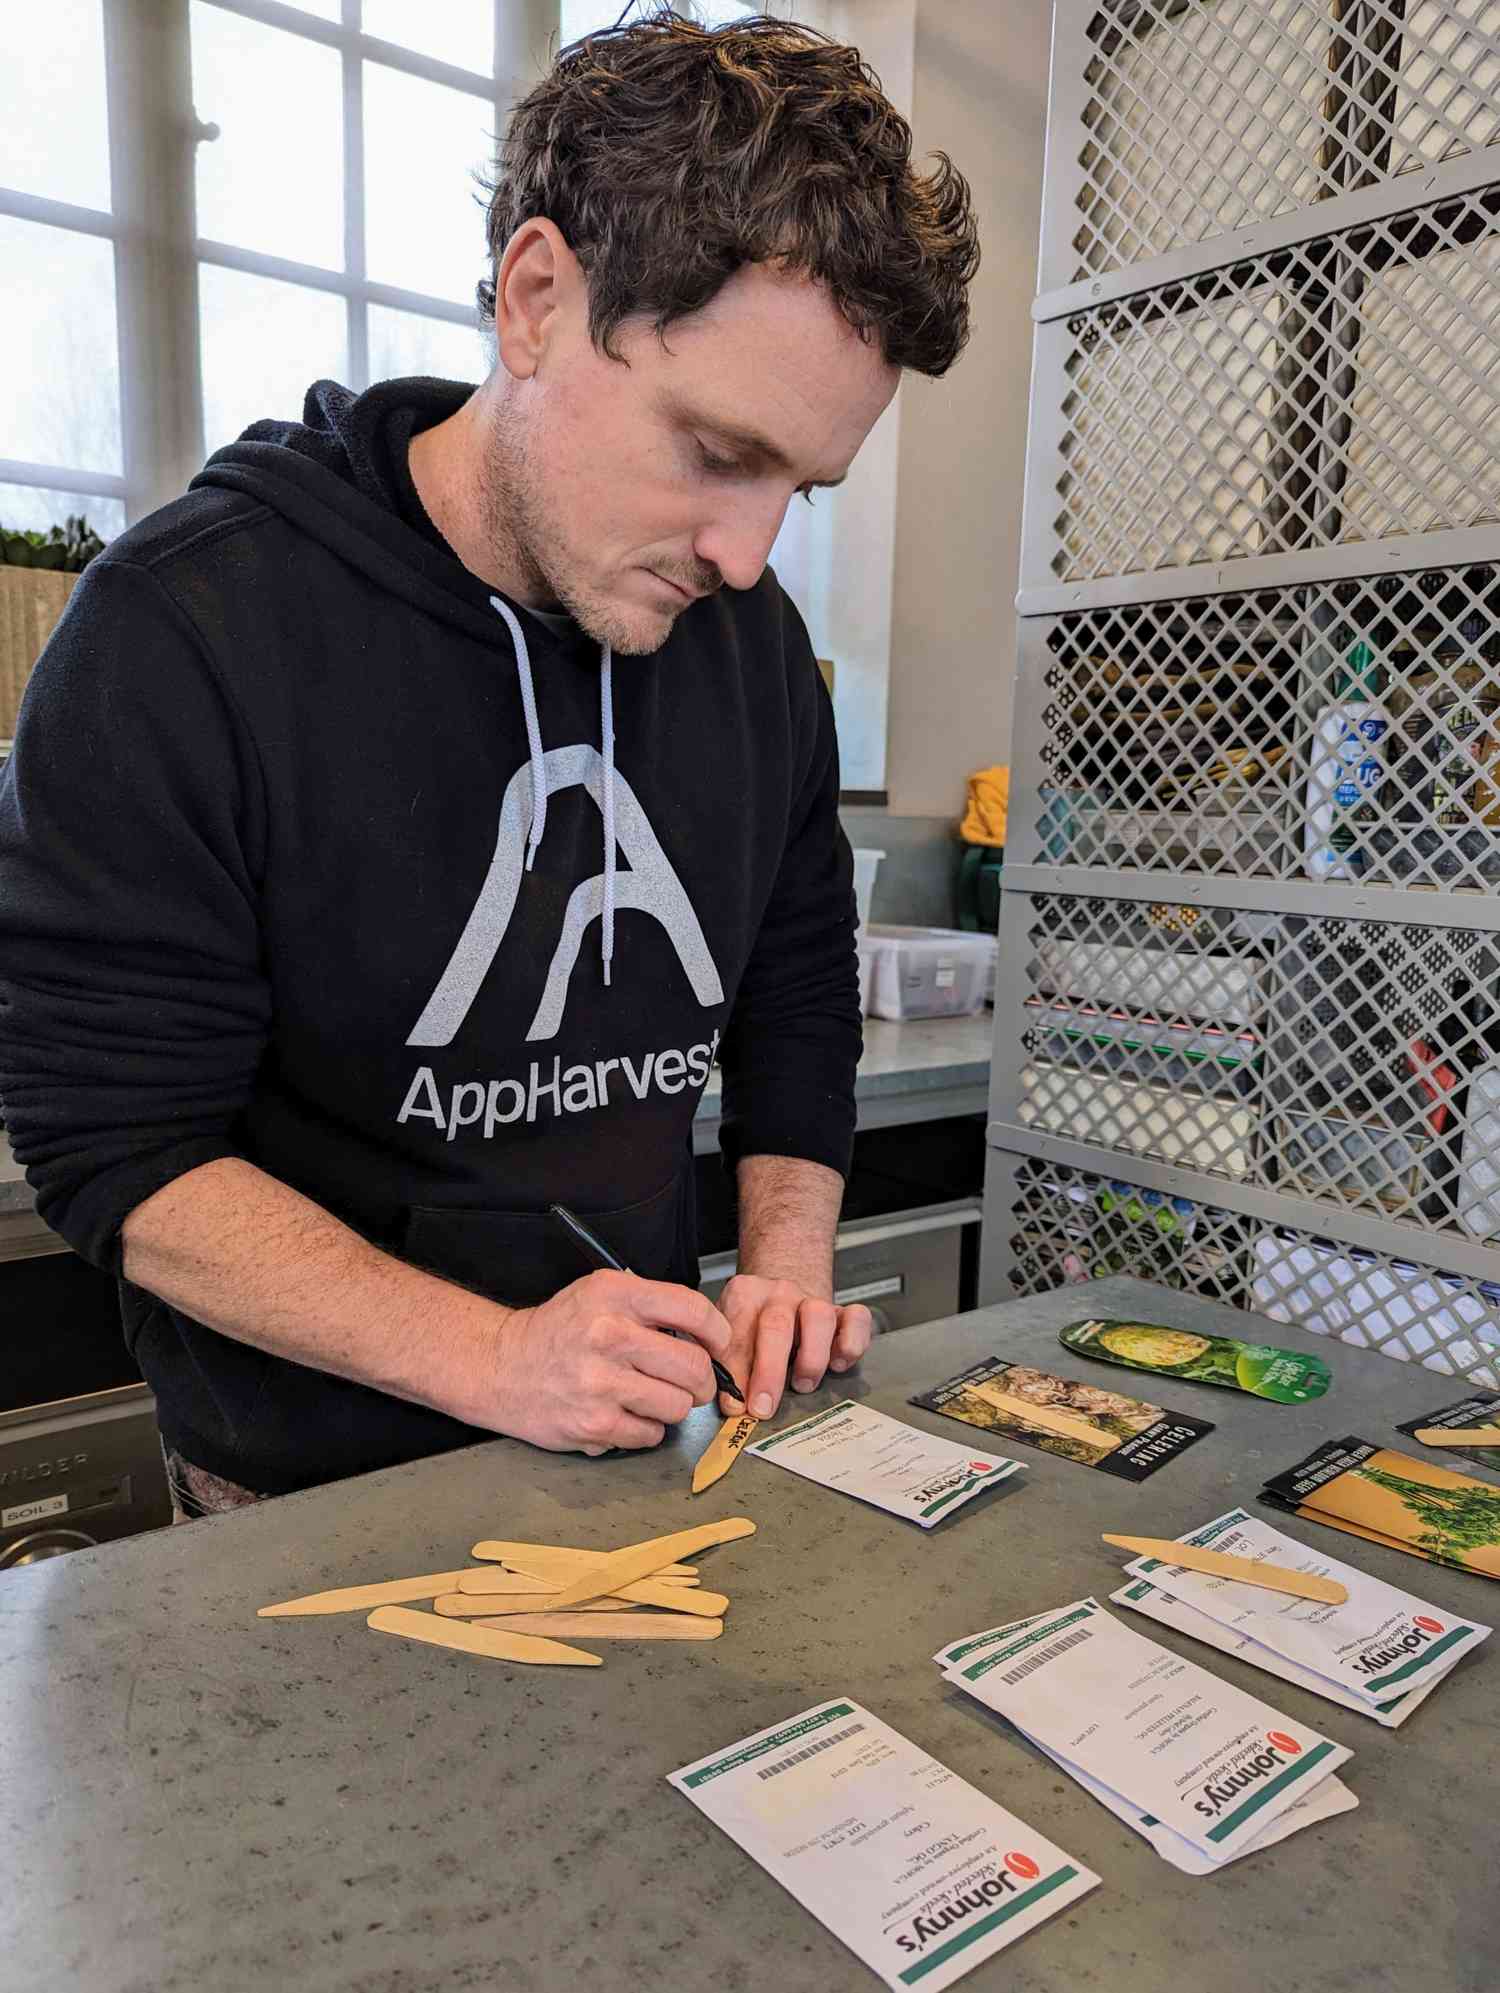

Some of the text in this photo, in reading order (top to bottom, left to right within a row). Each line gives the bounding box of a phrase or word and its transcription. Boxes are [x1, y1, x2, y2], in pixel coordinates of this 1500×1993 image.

[396, 1028, 720, 1142] AppHarvest
[1130, 1426, 1196, 1466] CELERIAC
[7, 1505, 45, 1521] SOIL
[1353, 1627, 1432, 1675] Johnny's
[1226, 1740, 1265, 1768] Selected
[1194, 1749, 1287, 1817] Johnny's
[881, 1894, 919, 1919] company
[896, 1870, 1017, 1953] Johnny's
[920, 1862, 997, 1915] Selected Seeds
